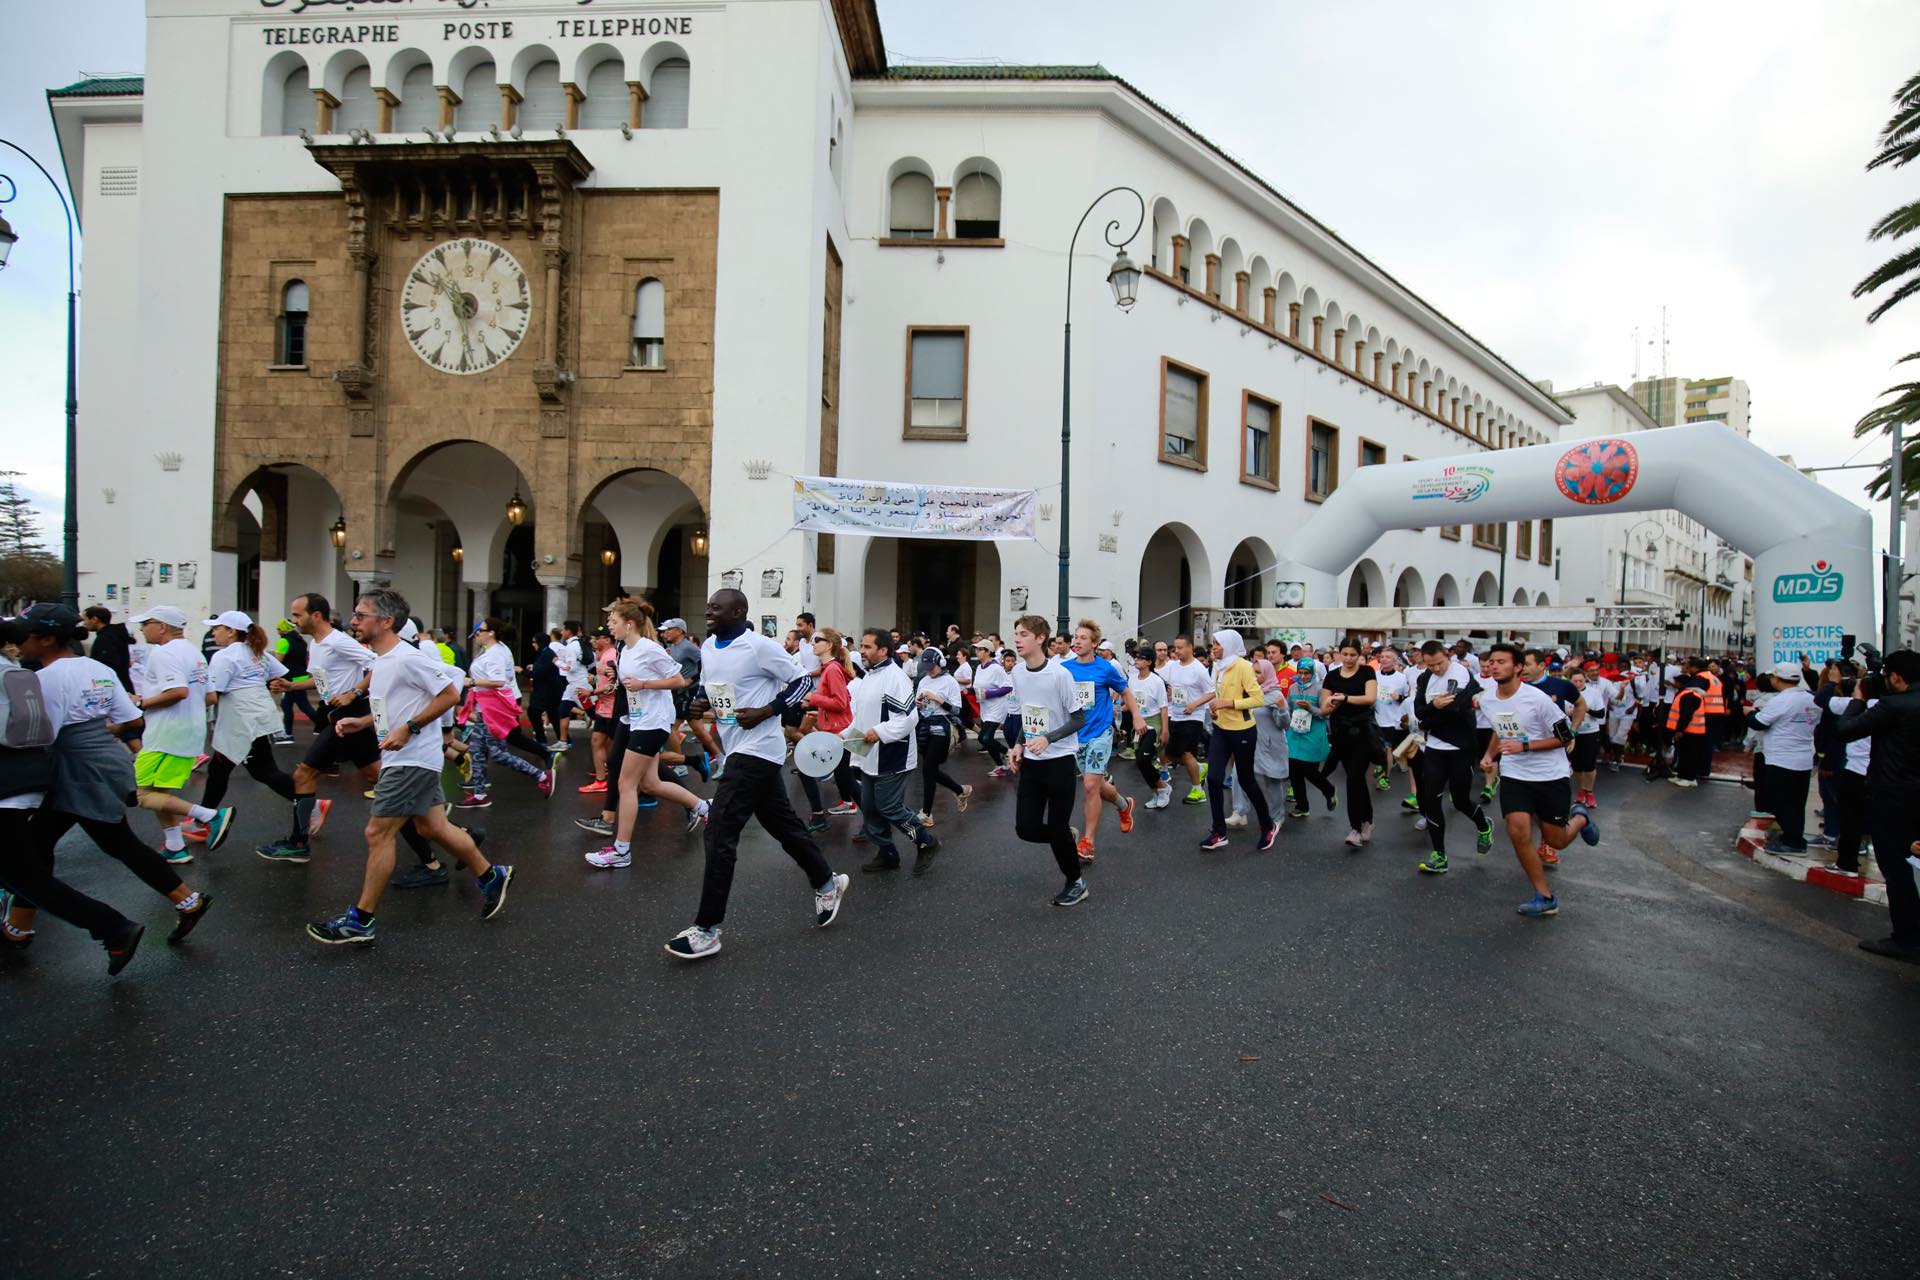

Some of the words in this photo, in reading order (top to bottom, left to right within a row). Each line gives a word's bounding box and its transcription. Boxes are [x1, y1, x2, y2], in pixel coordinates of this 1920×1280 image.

[263, 25, 399, 45] TELEGRAPHE
[443, 21, 514, 41] POSTE
[558, 17, 693, 38] TELEPHONE
[1443, 466, 1456, 477] 10
[839, 492, 865, 503] الرباط
[1777, 577, 1838, 595] MDJS
[1773, 625, 1844, 639] OBJECTIFS
[711, 696, 732, 708] 1633
[1025, 716, 1045, 727] 1144
[1498, 722, 1519, 731] 1418
